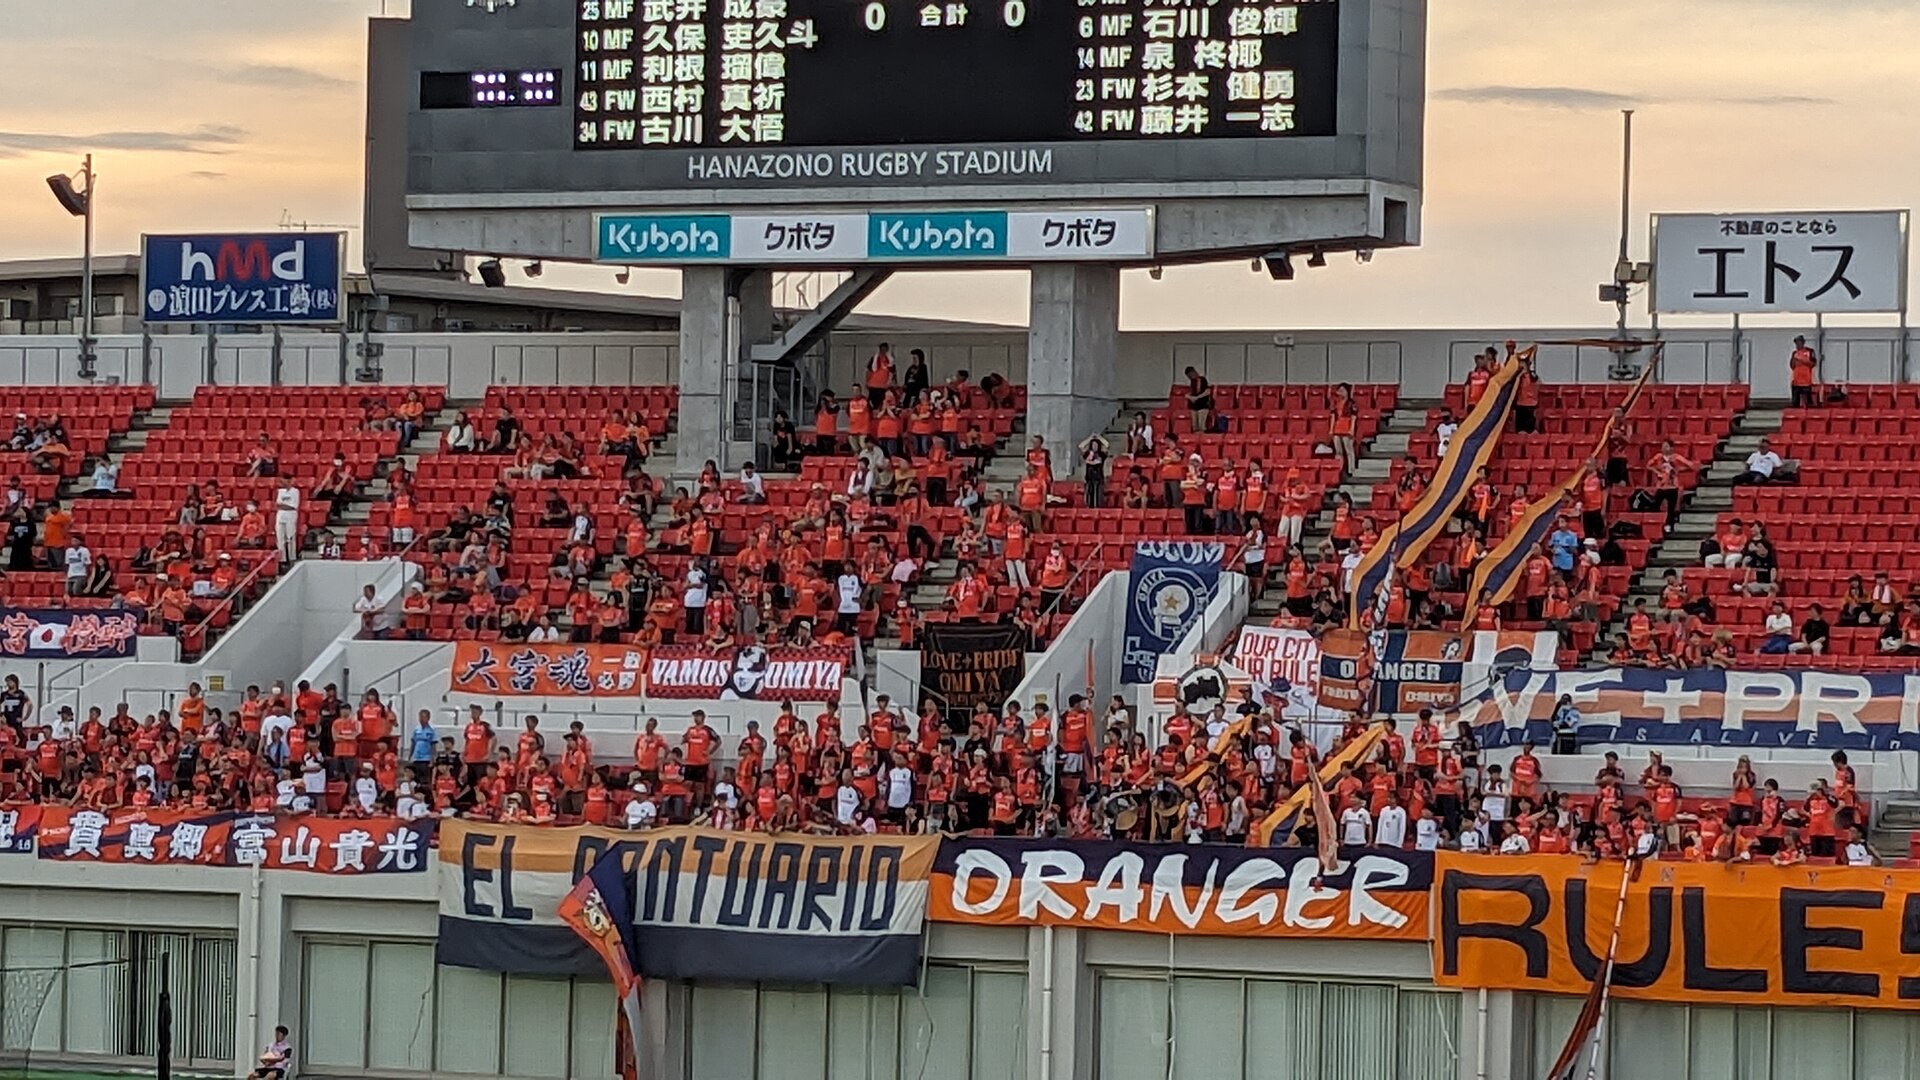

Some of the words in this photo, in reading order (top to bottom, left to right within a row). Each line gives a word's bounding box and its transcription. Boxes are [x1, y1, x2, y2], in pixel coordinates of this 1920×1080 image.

[603, 0, 634, 19] MF
[865, 2, 886, 31] 0
[920, 4, 968, 26] 合計
[1004, 0, 1026, 27] 0
[1079, 16, 1094, 38] 6
[1101, 15, 1132, 36] MF
[1143, 8, 1210, 38] 石川
[583, 30, 598, 51] 10
[603, 29, 634, 50] MF
[643, 24, 706, 52] 久保
[581, 60, 597, 81] 11
[603, 59, 633, 80] MF
[642, 54, 705, 82] 利根
[1100, 45, 1132, 67] MF
[1142, 41, 1175, 70] 泉
[603, 90, 636, 111] FW
[641, 85, 705, 113] 西村
[1101, 78, 1136, 99] FW
[1142, 72, 1210, 102] 杉本
[1226, 70, 1294, 100] 健勇
[580, 121, 598, 142] 34
[603, 120, 636, 141] FW
[641, 115, 703, 144] 古川
[719, 113, 784, 142] 大悟
[1101, 109, 1136, 131] FW
[1140, 104, 1209, 134] 藤井
[1226, 102, 1295, 131] 一志
[688, 154, 833, 179] HANAZONO
[841, 152, 928, 176] RUGBY
[935, 149, 1053, 174] STADIUM
[608, 222, 719, 252] Kubota
[765, 222, 834, 250] クボタ
[879, 219, 995, 250] Kubota
[1042, 219, 1117, 247] クボタ
[1720, 220, 1838, 236] 不動産のことなら
[1693, 240, 1862, 304] エトス
[922, 649, 962, 670] LOVE
[1242, 632, 1279, 658] OUR
[458, 648, 594, 694] 大宮魂
[652, 658, 731, 686] VAMOS
[764, 661, 842, 690] OMIYA
[1340, 660, 1441, 681] OANGER
[1690, 728, 1819, 746] ALIVE
[233, 823, 420, 872] 富山貴光
[462, 832, 533, 920] EL
[952, 848, 1409, 929] ORANGER
[1441, 868, 1920, 1001] RULE
